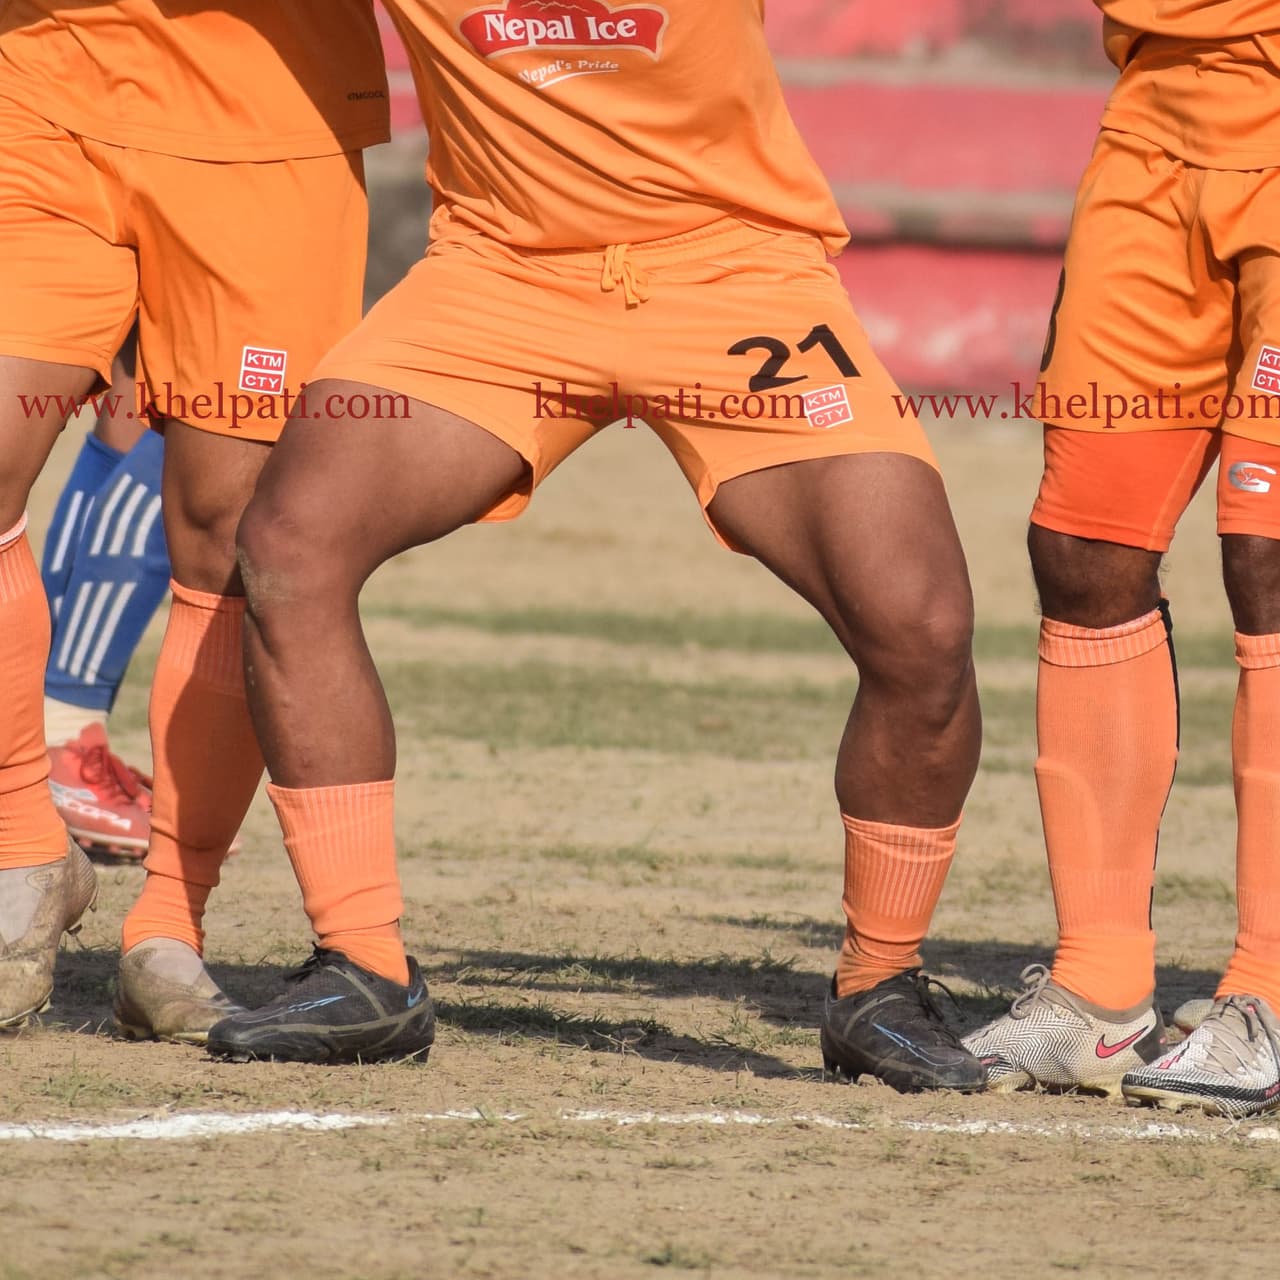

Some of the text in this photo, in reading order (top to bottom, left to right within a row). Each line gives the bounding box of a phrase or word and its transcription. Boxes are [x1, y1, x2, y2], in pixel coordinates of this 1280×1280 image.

[483, 14, 637, 47] Nepal Ice
[578, 60, 619, 70] Pride
[247, 353, 282, 368] KTM
[727, 323, 862, 393] 21
[245, 374, 280, 389] CTY
[808, 390, 840, 406] KTM
[814, 408, 844, 425] CTY
